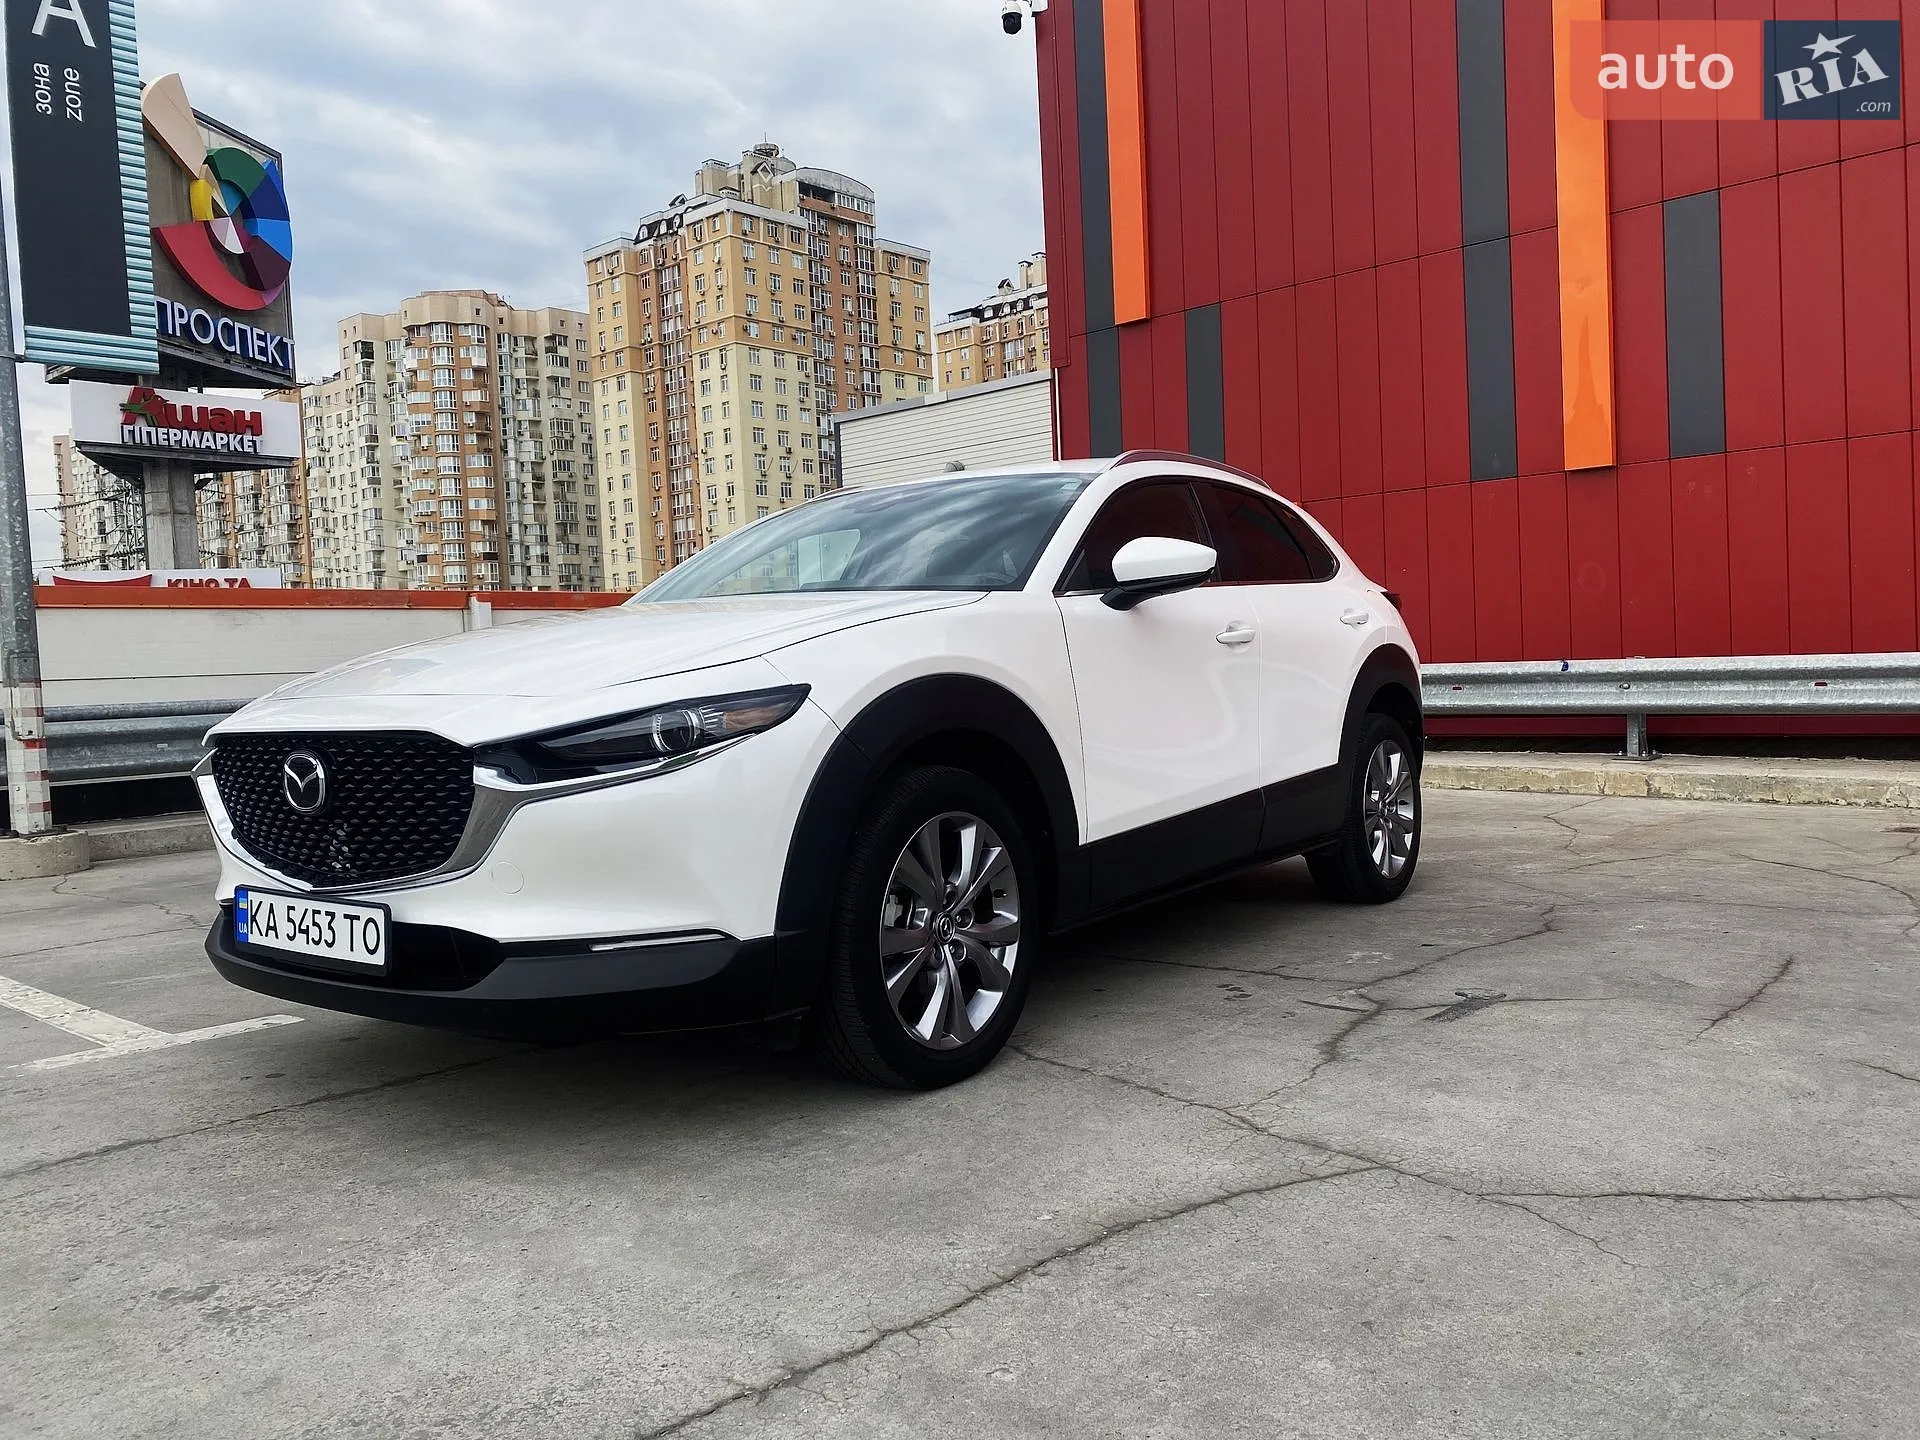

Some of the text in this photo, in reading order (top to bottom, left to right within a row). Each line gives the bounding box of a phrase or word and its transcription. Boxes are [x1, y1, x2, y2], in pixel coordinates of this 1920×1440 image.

[33, 62, 52, 115] зона
[63, 67, 82, 122] zone
[154, 296, 295, 370] ПРОСПЕКТ
[120, 386, 264, 436] Ашан
[120, 425, 264, 453] ГІПЕРМАРКЕТ
[239, 922, 248, 933] UA
[286, 905, 336, 948] 5453
